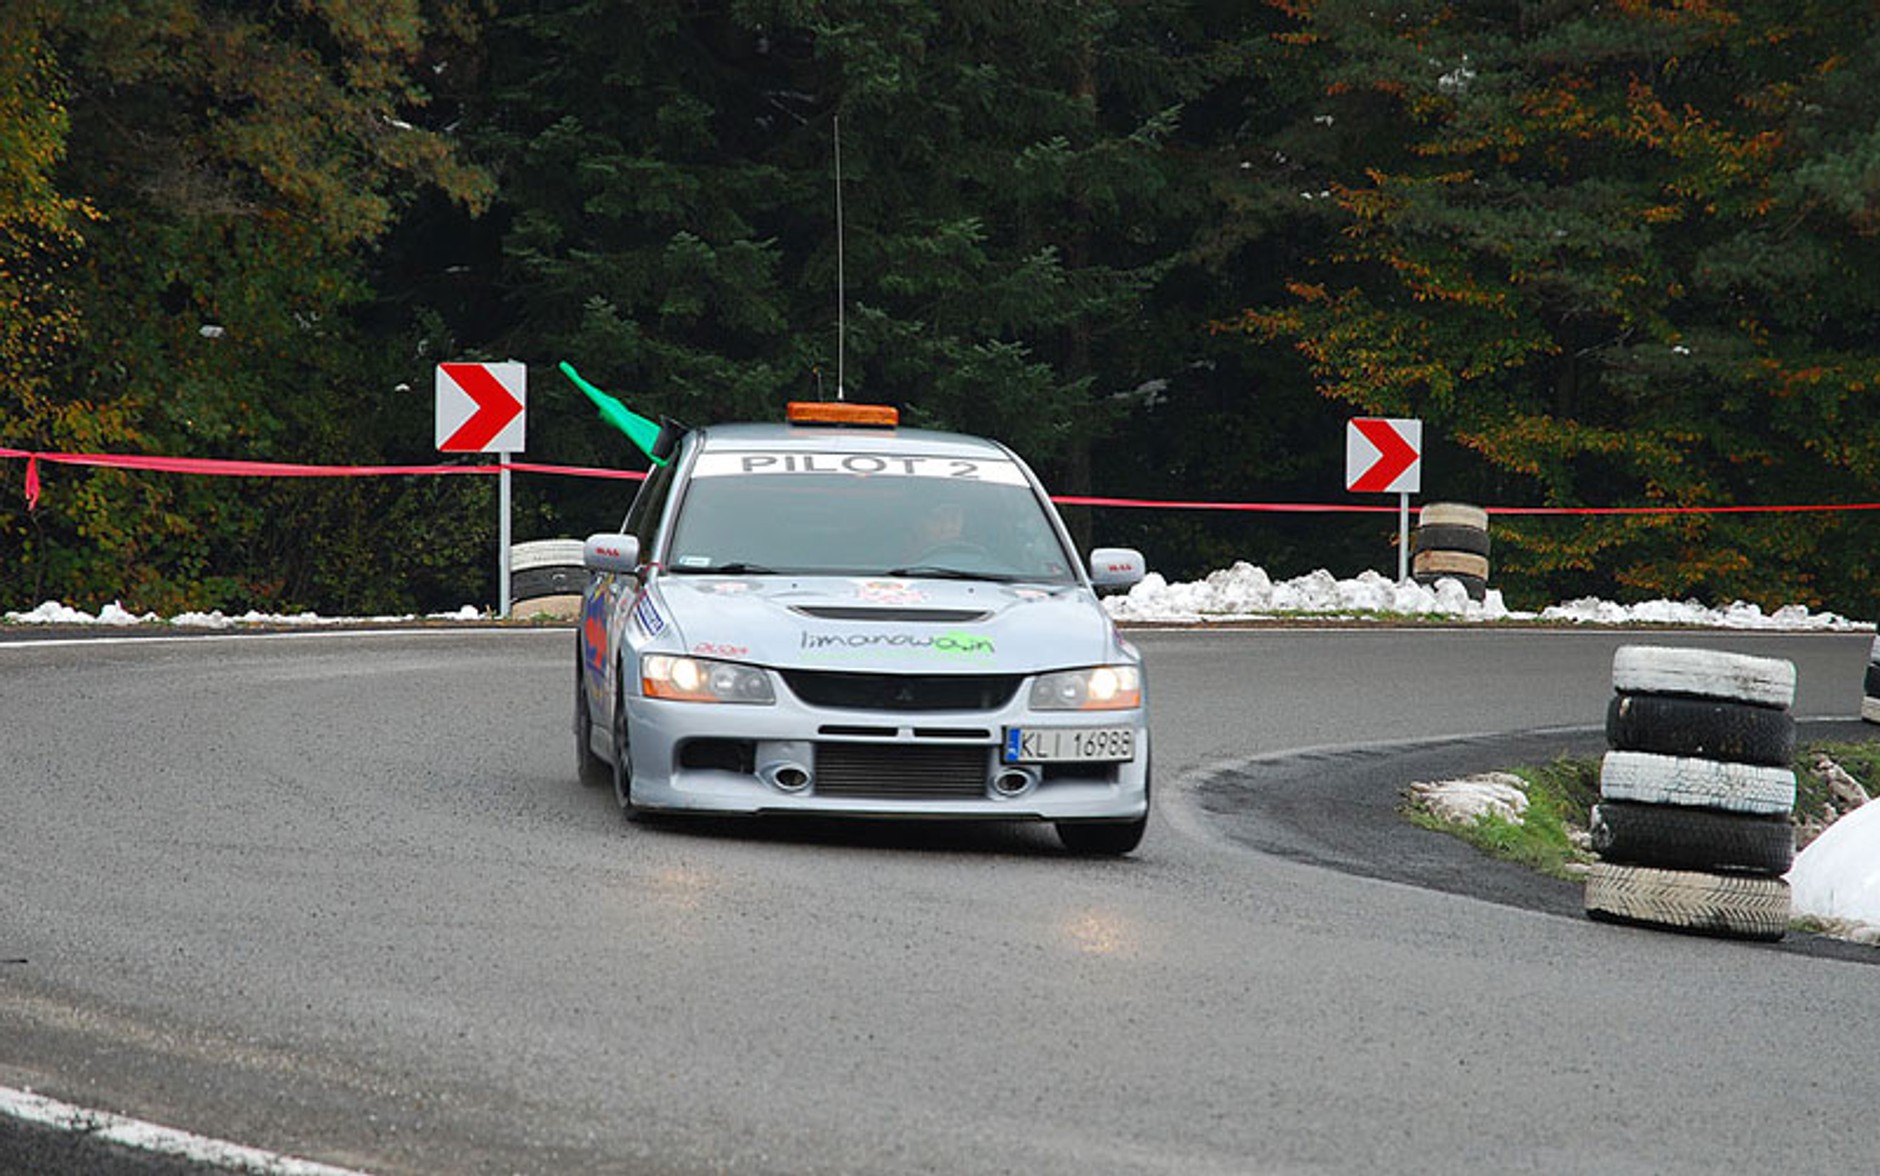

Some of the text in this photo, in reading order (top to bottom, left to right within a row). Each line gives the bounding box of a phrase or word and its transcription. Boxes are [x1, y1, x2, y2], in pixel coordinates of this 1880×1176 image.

[741, 455, 980, 479] PILOT 2
[1021, 730, 1131, 757] KLI 16988
